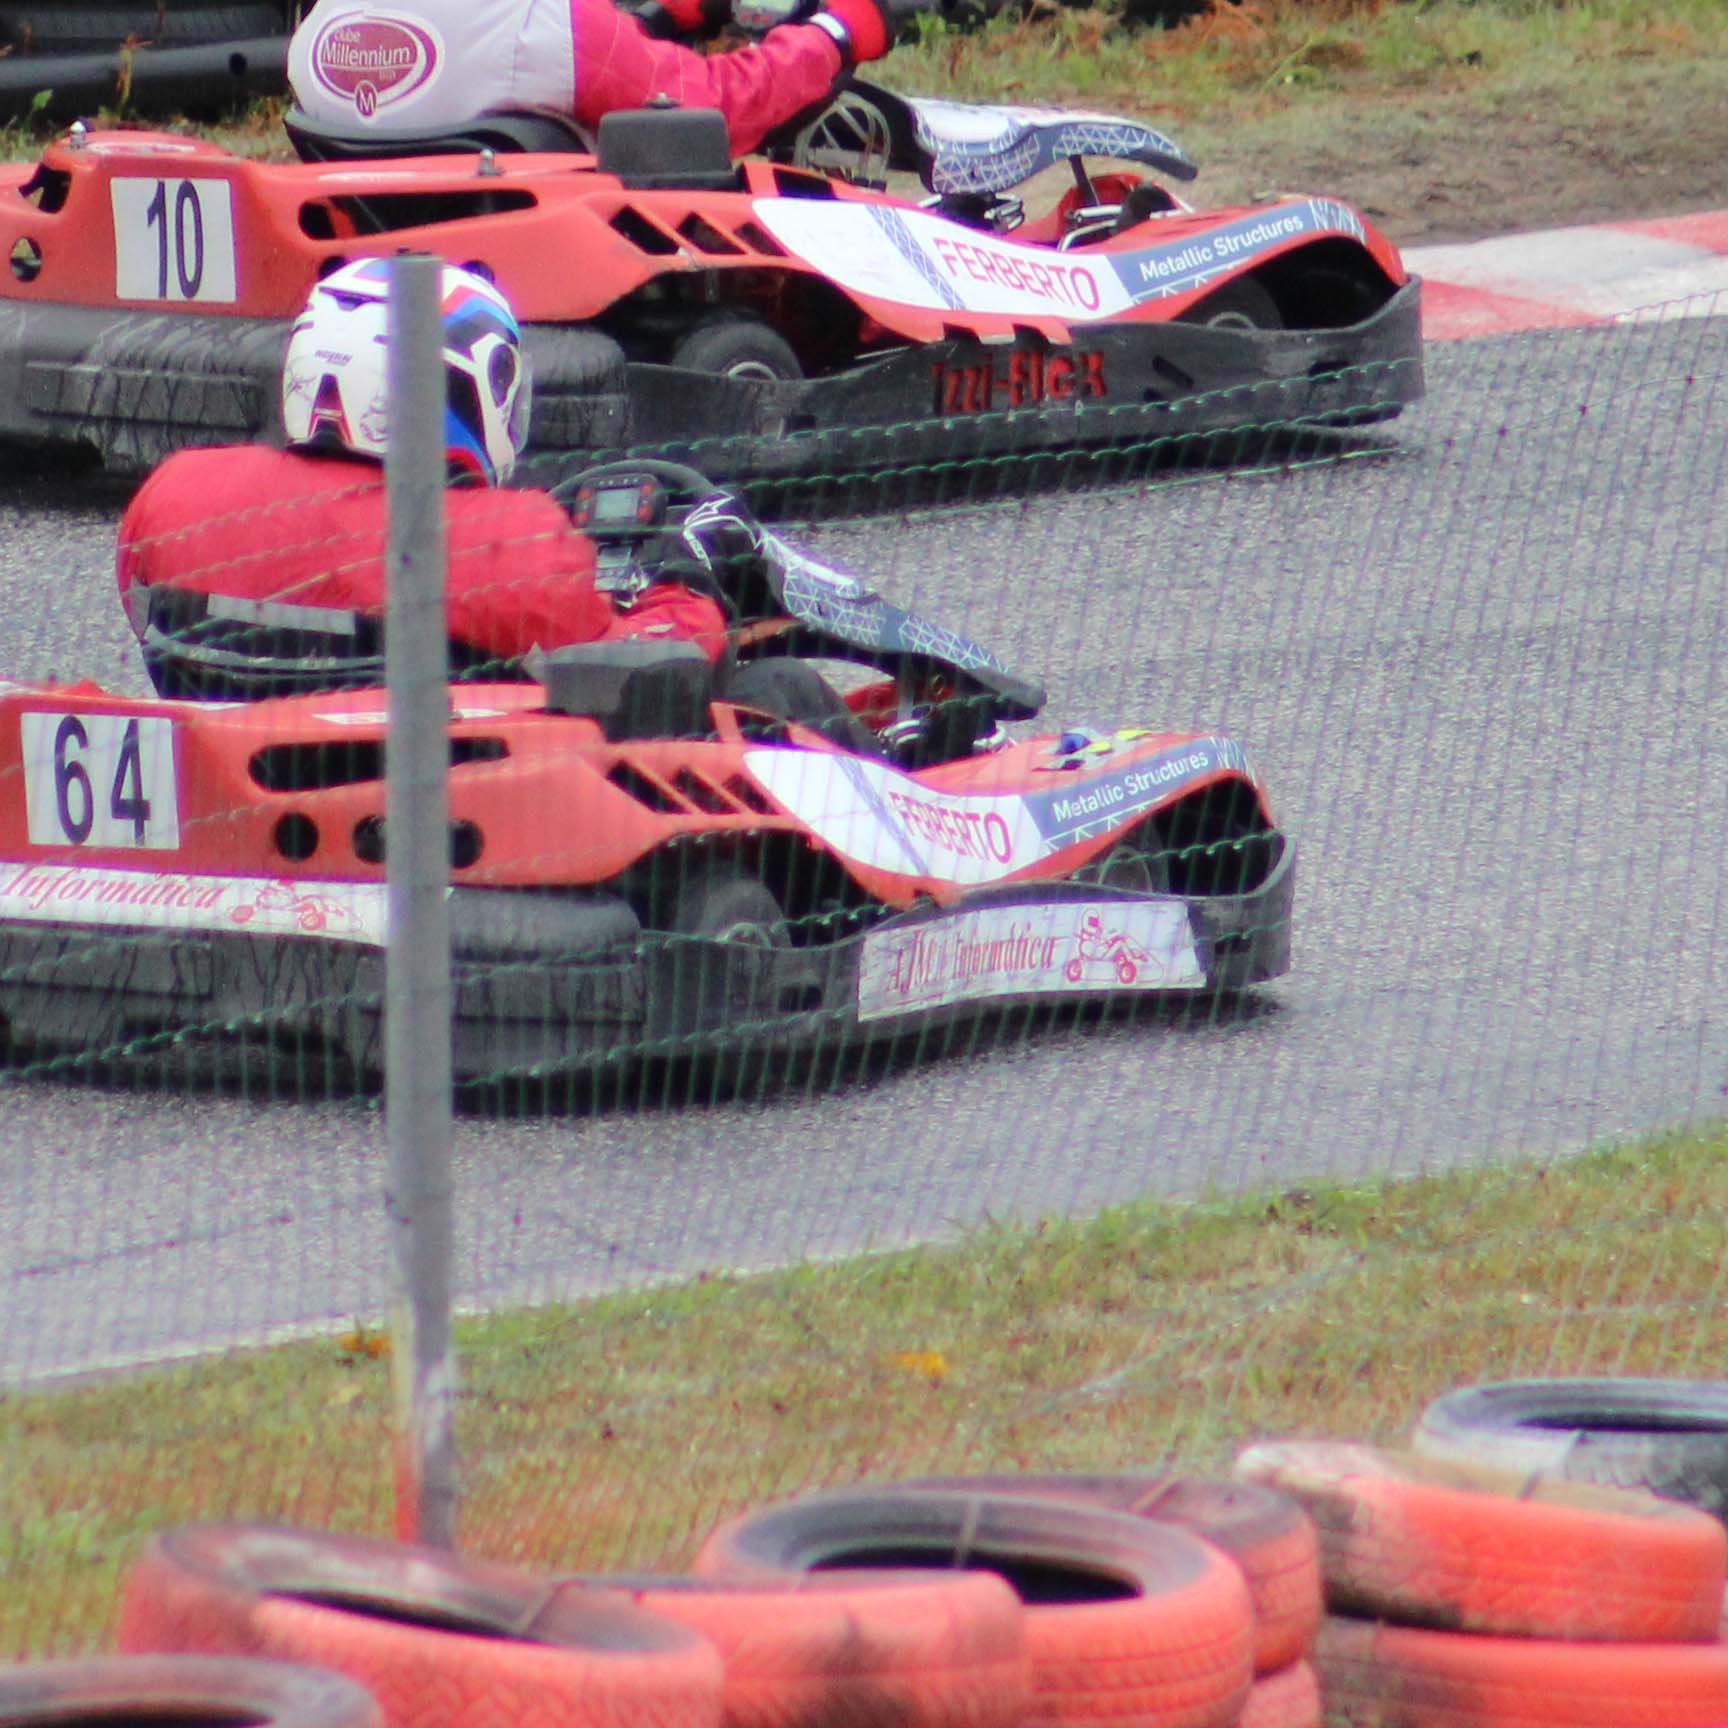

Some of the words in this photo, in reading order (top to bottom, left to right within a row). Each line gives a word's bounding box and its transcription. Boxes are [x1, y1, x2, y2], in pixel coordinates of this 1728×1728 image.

[322, 39, 411, 67] Millennium
[359, 88, 375, 113] M
[146, 180, 204, 300] 10
[933, 236, 1100, 312] FERBERTO
[1139, 239, 1213, 282] Metallic
[1214, 214, 1304, 257] Structures
[54, 715, 151, 847] 64
[889, 791, 1012, 865] FERBERTO
[1052, 779, 1124, 823] Metallic
[1124, 749, 1209, 798] Structures
